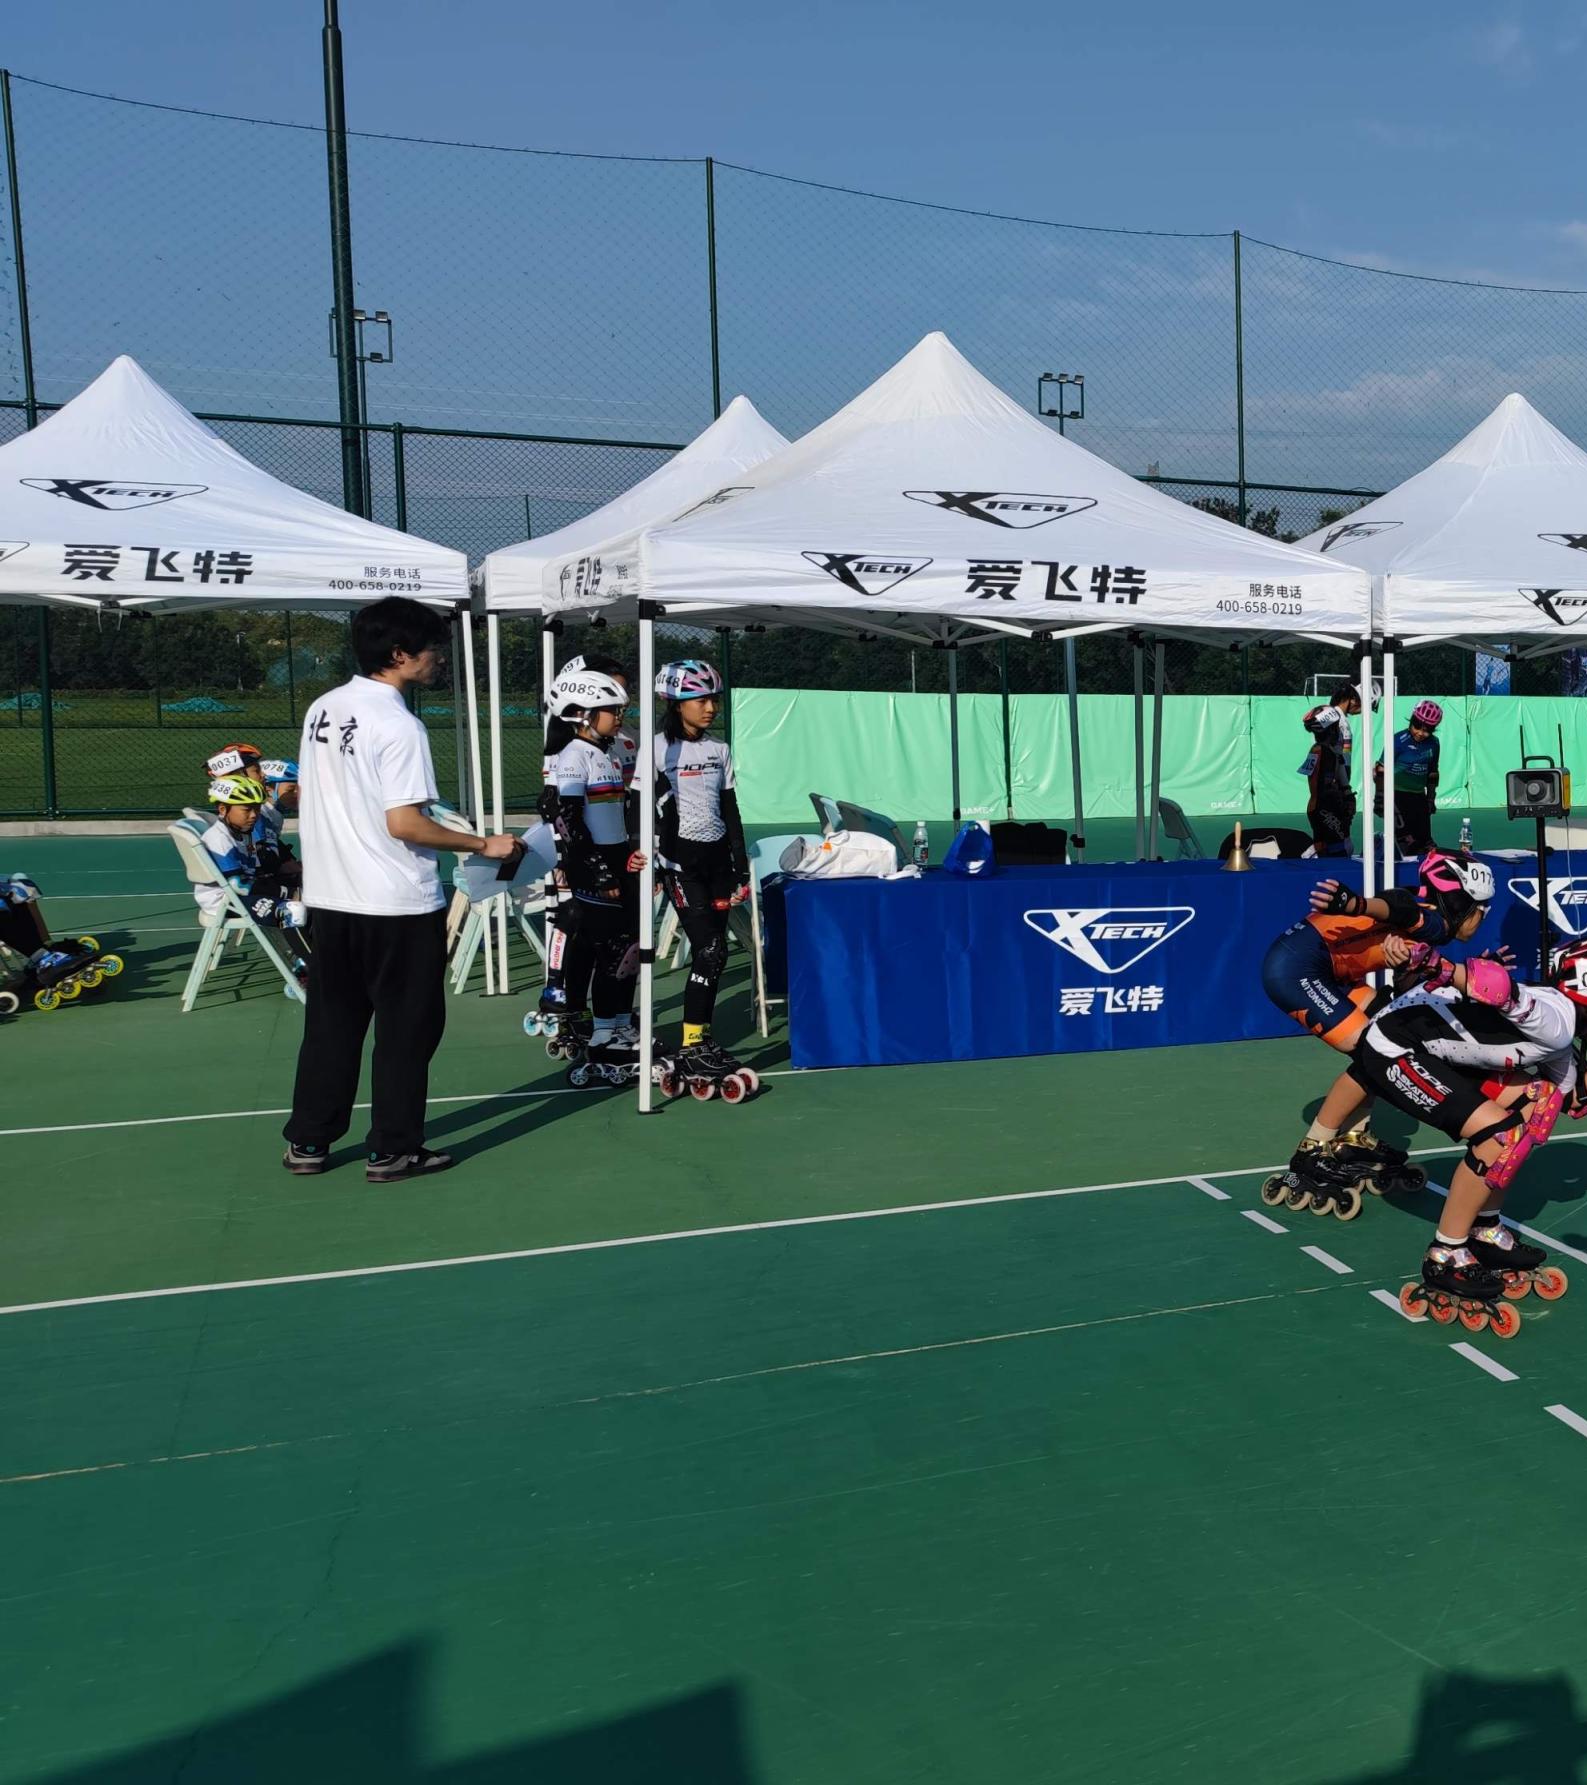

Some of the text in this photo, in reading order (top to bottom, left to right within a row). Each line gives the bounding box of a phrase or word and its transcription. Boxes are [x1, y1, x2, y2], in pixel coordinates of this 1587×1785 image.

[935, 491, 1068, 528] XTECH
[60, 543, 253, 584] 爱飞特
[364, 566, 421, 579] 服务电话
[822, 553, 912, 595] XTECH
[965, 559, 1147, 605] 爱飞特
[328, 579, 422, 591] 400-658-0219
[1249, 583, 1302, 599] 服务电话
[1216, 599, 1303, 615] 400-658-0219
[309, 709, 358, 757] 北京
[211, 755, 237, 772] 0037
[1050, 910, 1168, 973] XTECH
[1059, 986, 1164, 1015] 爱飞特
[1299, 977, 1334, 1016] ZHONGLUN
[1400, 1074, 1440, 1107] SKATING
[1407, 1055, 1454, 1096] HOPE
